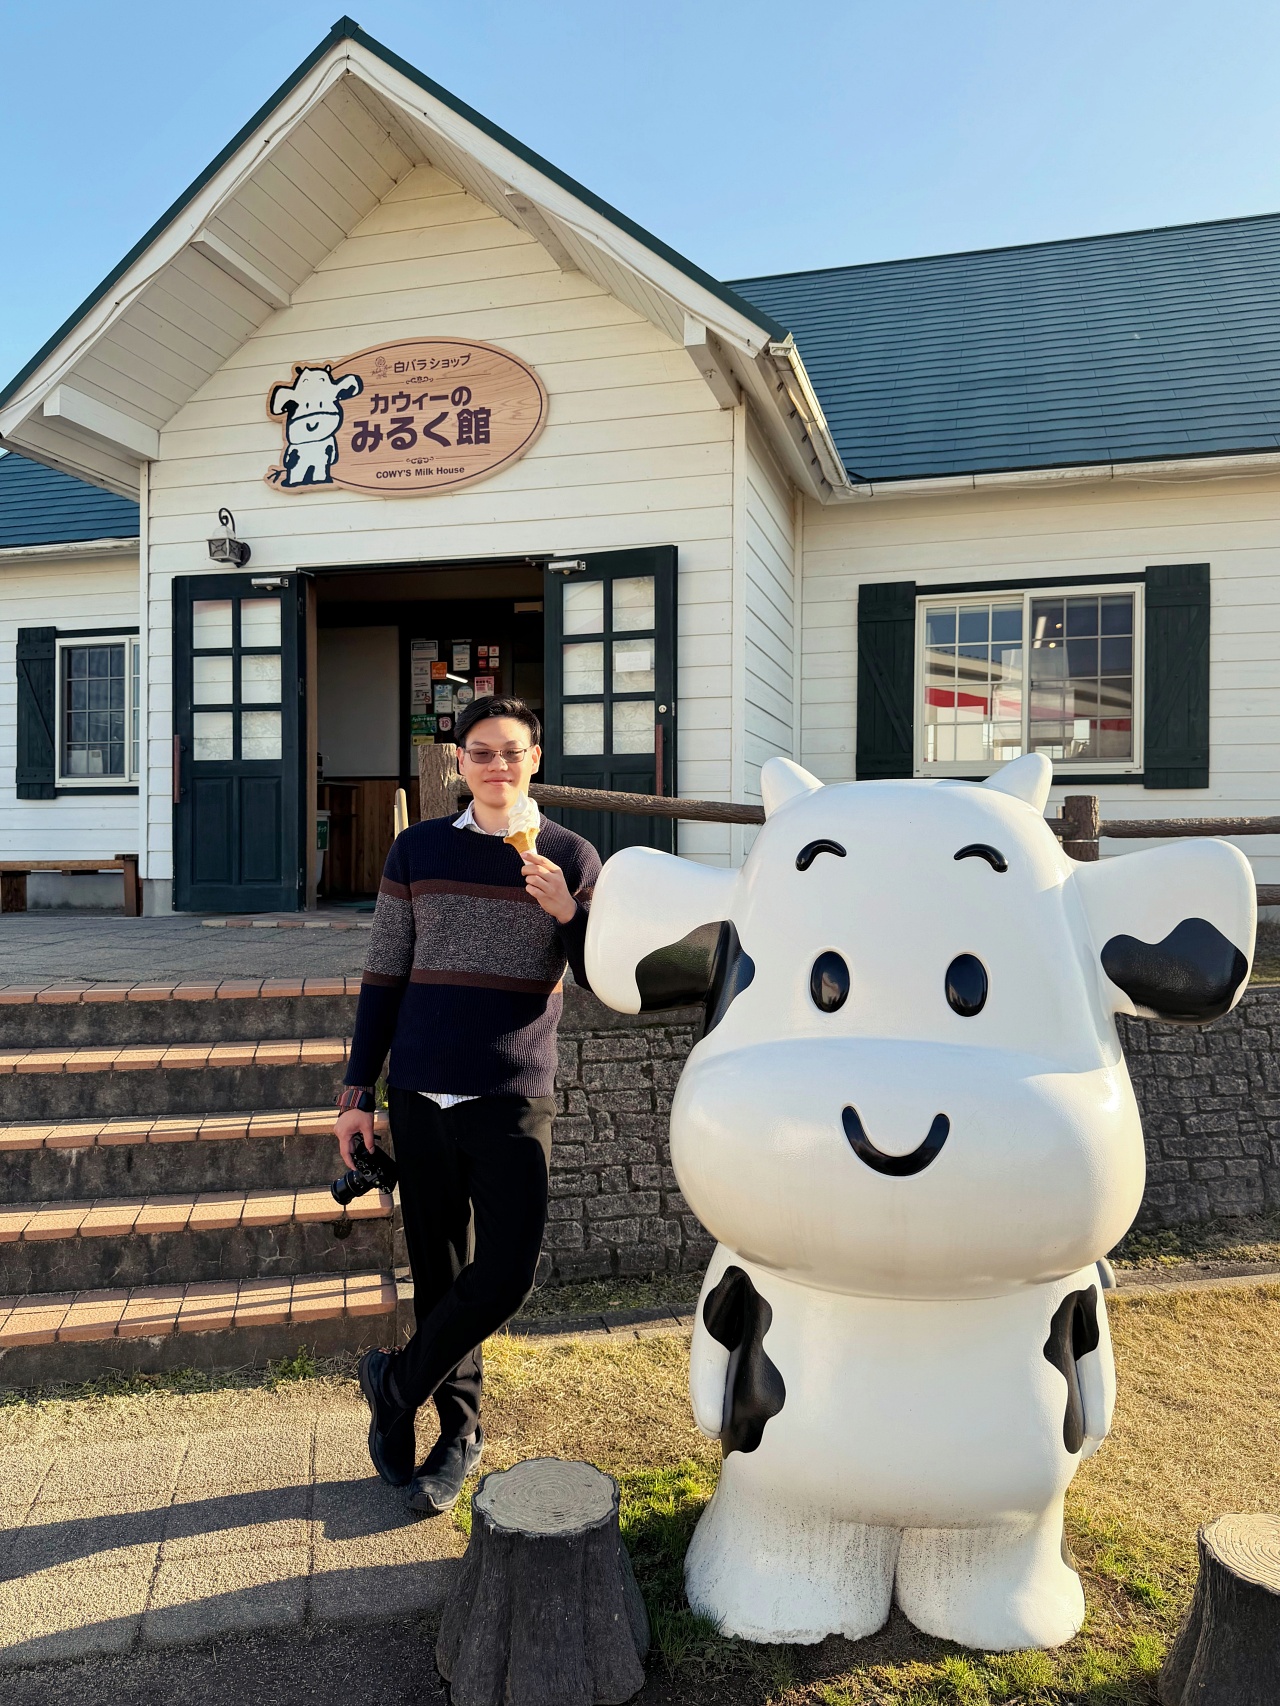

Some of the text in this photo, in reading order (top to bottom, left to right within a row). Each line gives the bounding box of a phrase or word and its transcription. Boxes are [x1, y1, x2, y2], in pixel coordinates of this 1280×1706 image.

[394, 353, 471, 373] 白バラショップ
[370, 386, 472, 415] カウィーの
[351, 407, 491, 453] みるく館
[376, 467, 465, 479] COWY'S Milk House
